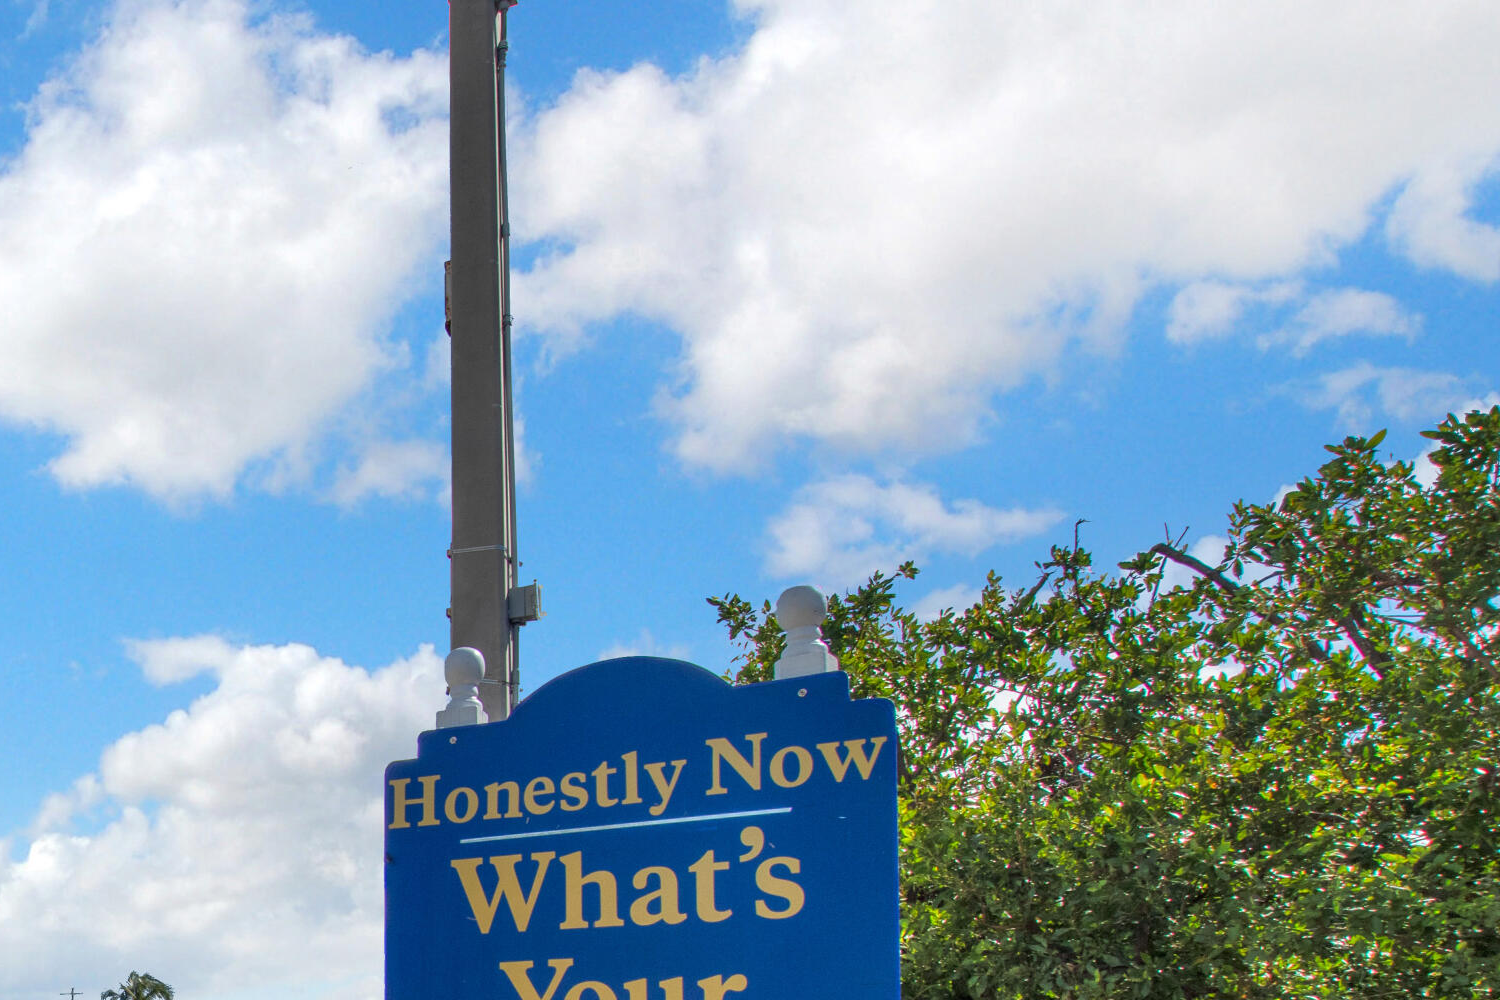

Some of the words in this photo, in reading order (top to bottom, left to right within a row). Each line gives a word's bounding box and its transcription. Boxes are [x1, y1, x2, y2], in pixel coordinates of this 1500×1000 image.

[390, 752, 686, 828] Honestly
[707, 733, 886, 794] Now
[451, 826, 805, 934] What's
